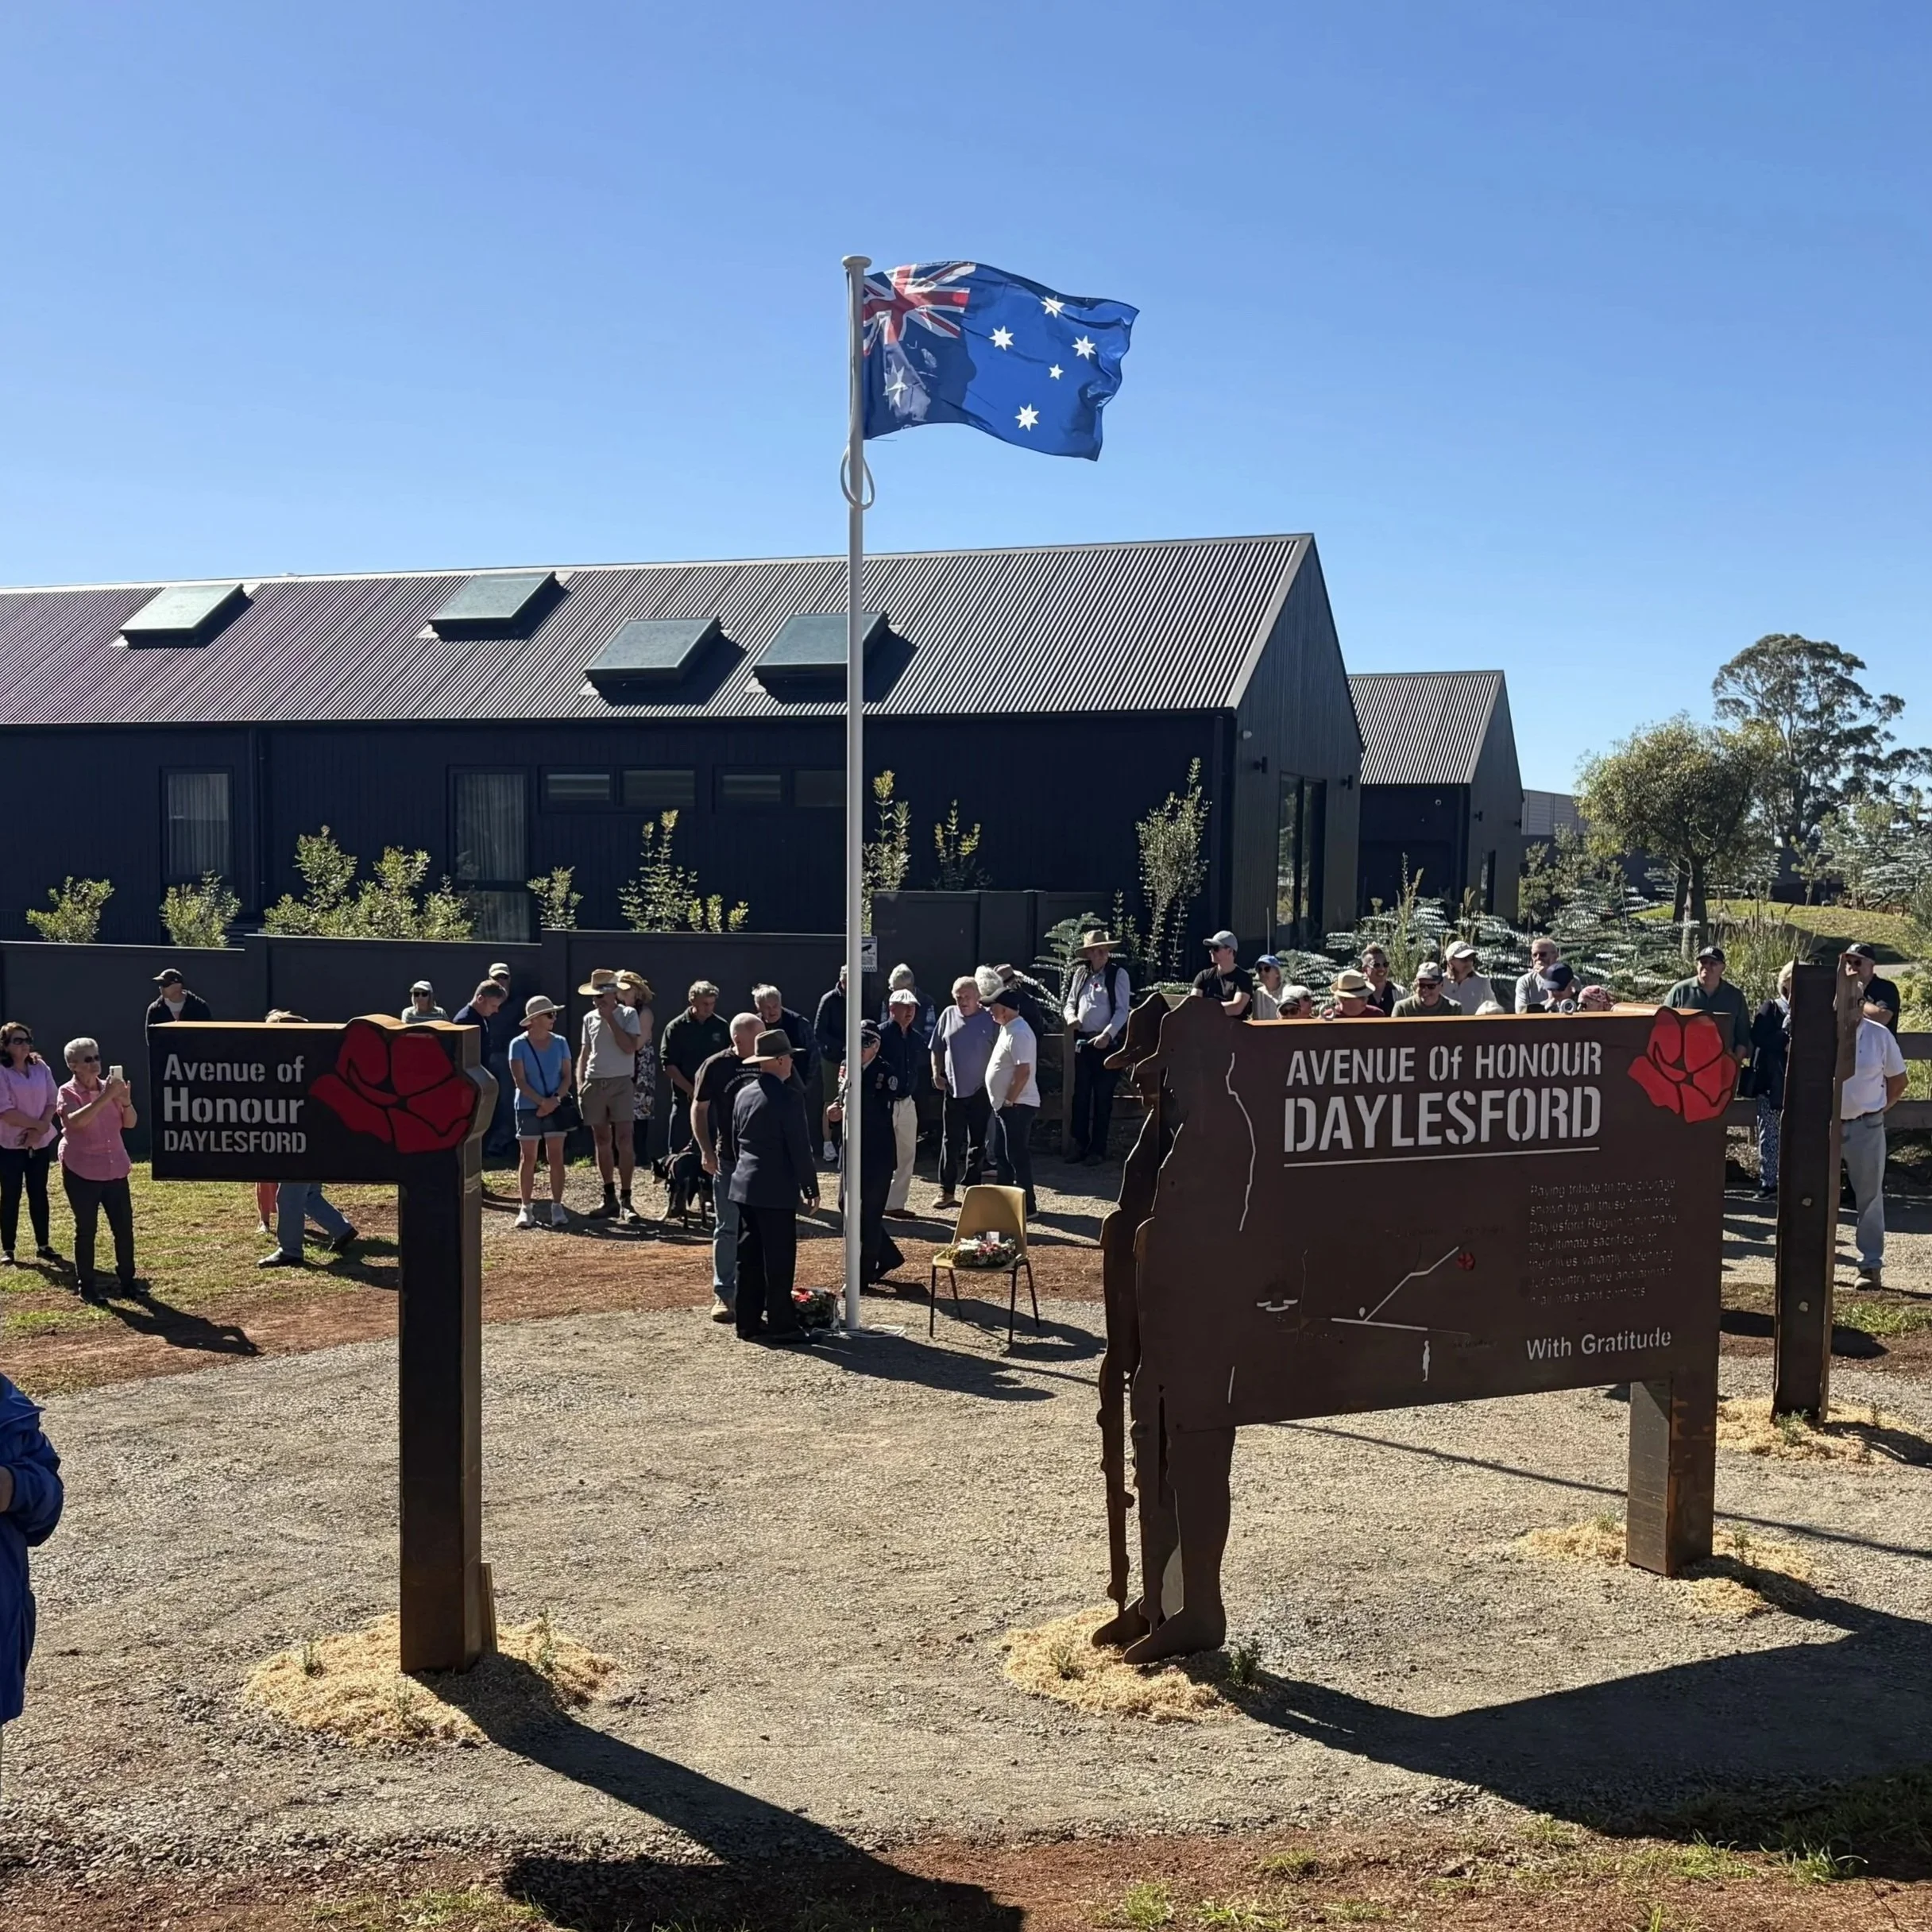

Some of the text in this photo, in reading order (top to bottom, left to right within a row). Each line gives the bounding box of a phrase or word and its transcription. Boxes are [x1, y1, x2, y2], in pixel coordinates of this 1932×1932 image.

[164, 1053, 305, 1083] Avenue of
[1286, 1047, 1416, 1086] AVENUE
[1475, 1041, 1602, 1079] HONOUR
[164, 1087, 304, 1124] Honour
[1284, 1086, 1601, 1153] DAYLESFORD
[164, 1130, 307, 1153] DAYLESFORD
[1526, 1336, 1572, 1360] With
[1581, 1327, 1672, 1354] Gratitude
